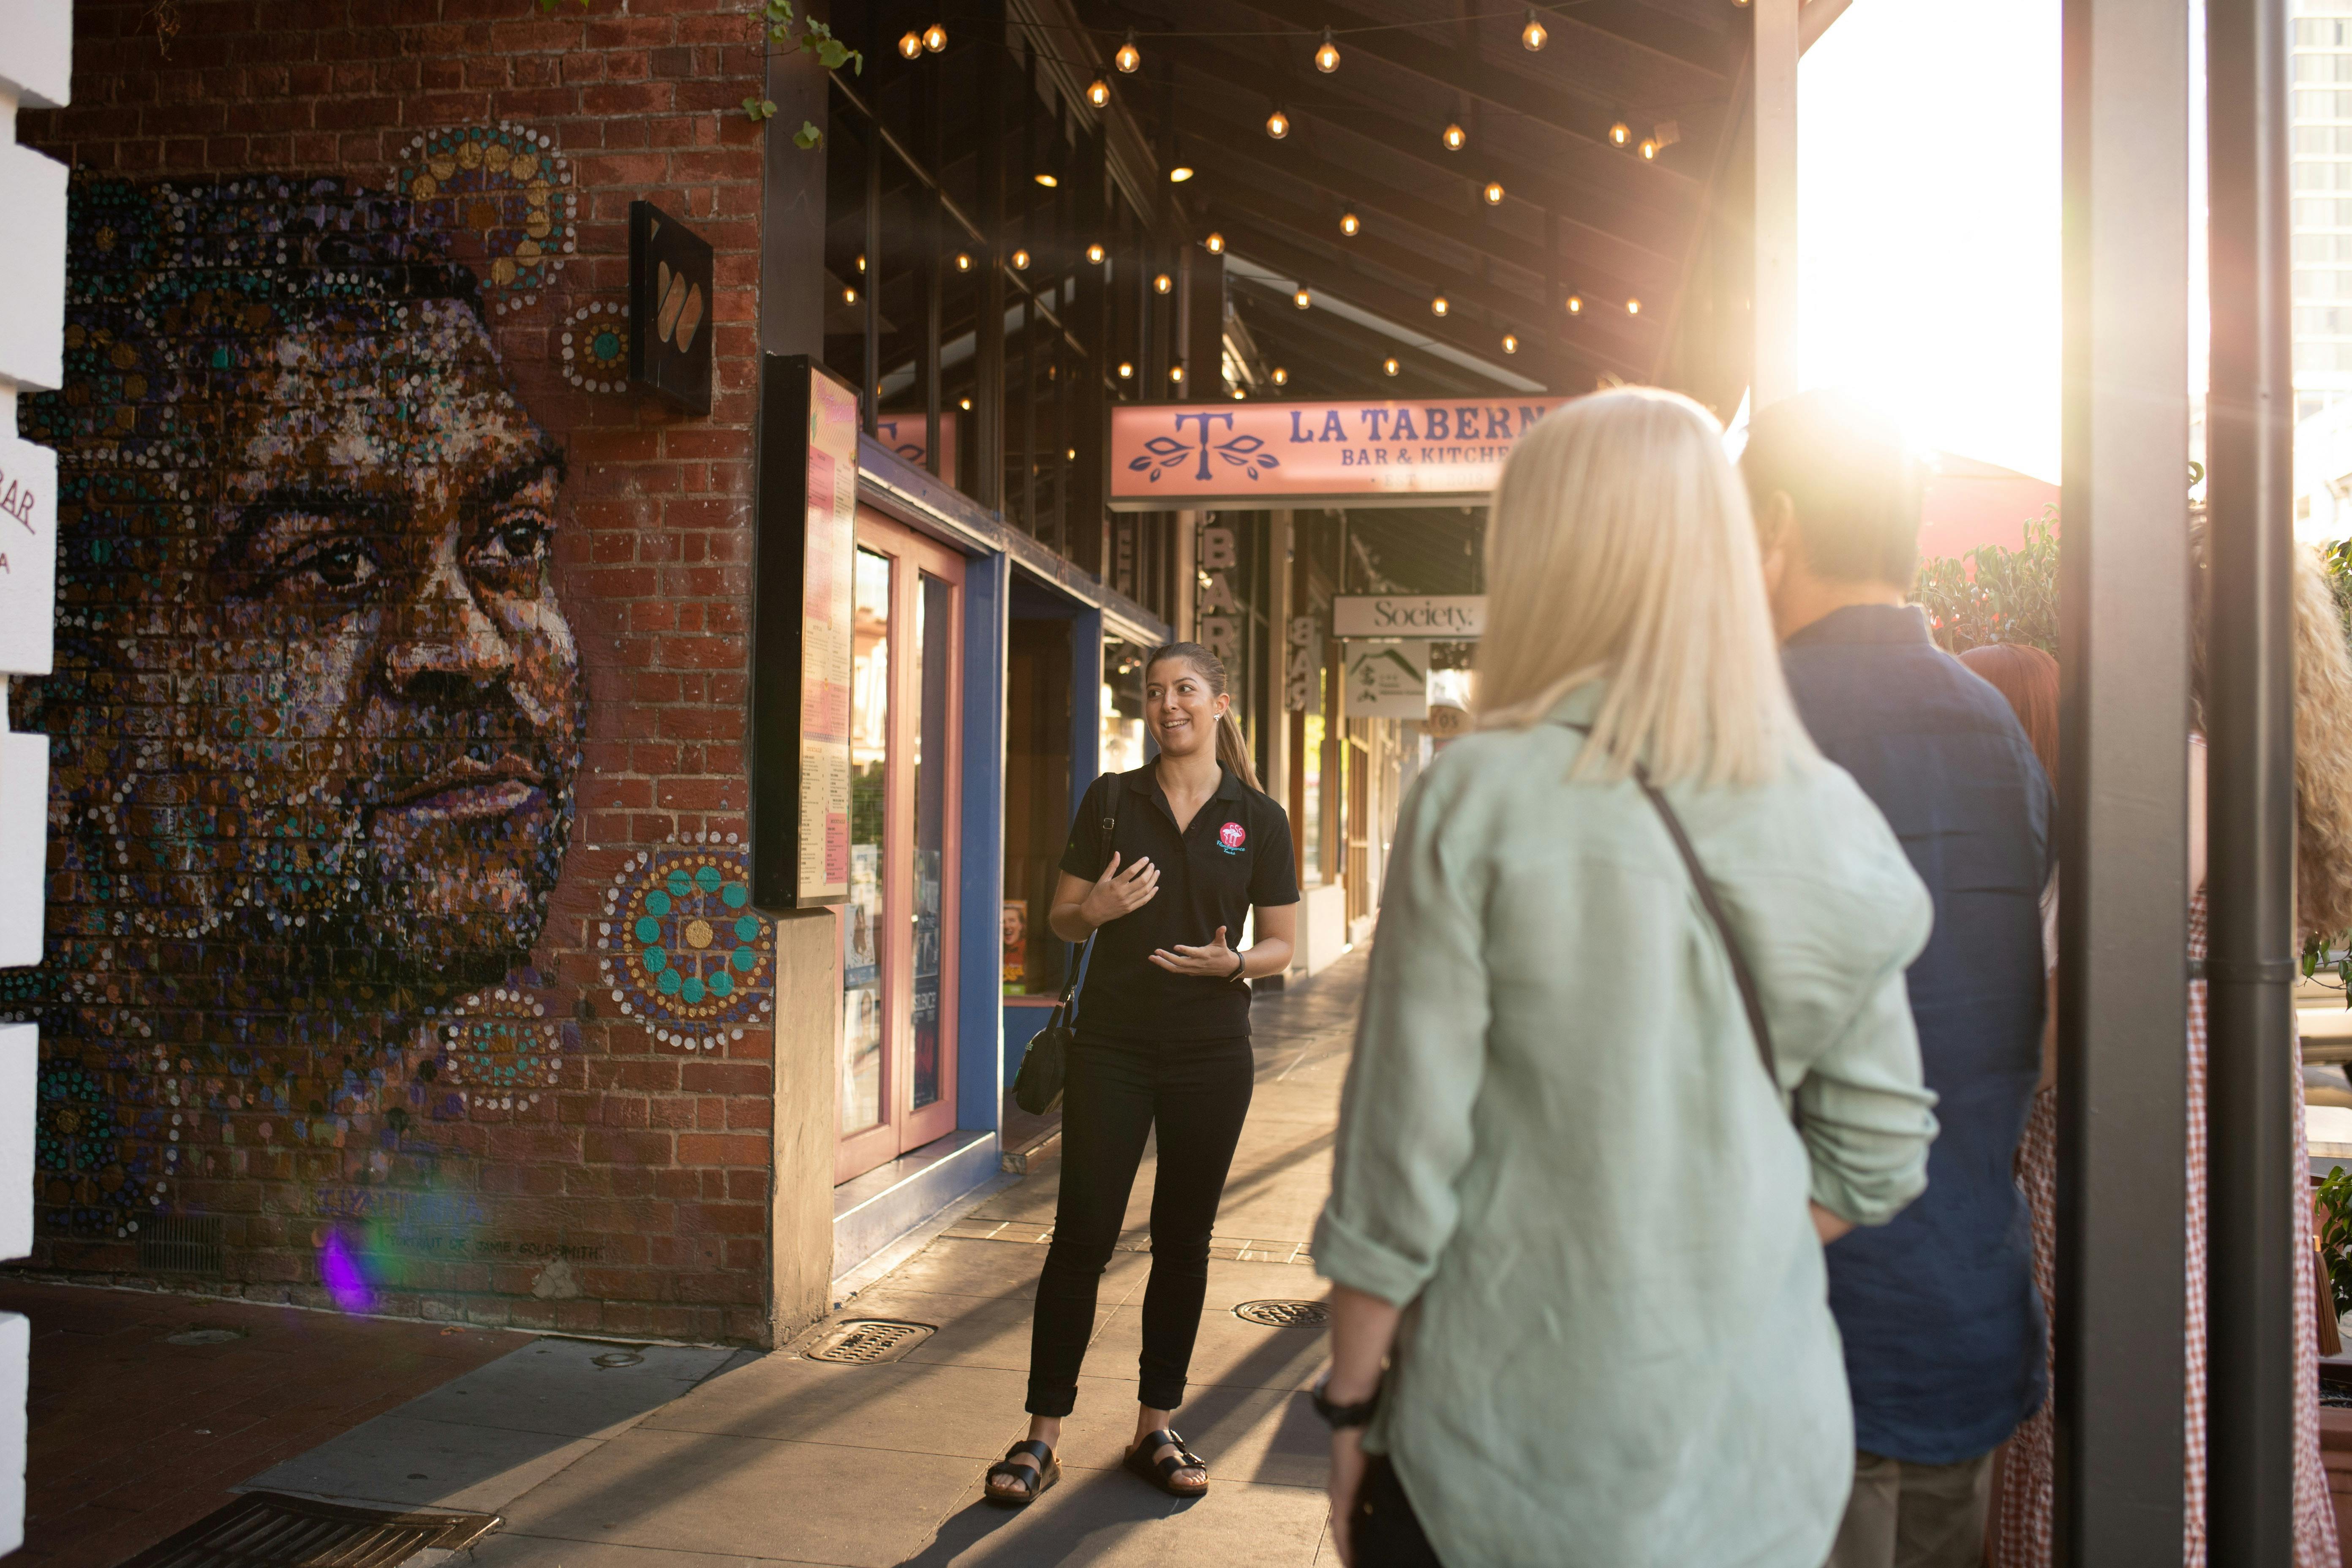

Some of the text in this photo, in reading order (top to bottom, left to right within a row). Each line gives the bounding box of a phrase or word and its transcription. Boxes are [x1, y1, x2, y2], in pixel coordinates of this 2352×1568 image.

[1289, 410, 1348, 443] LA
[1341, 449, 1388, 466] BAR
[1396, 449, 1412, 465] &
[1201, 527, 1237, 658] BAR
